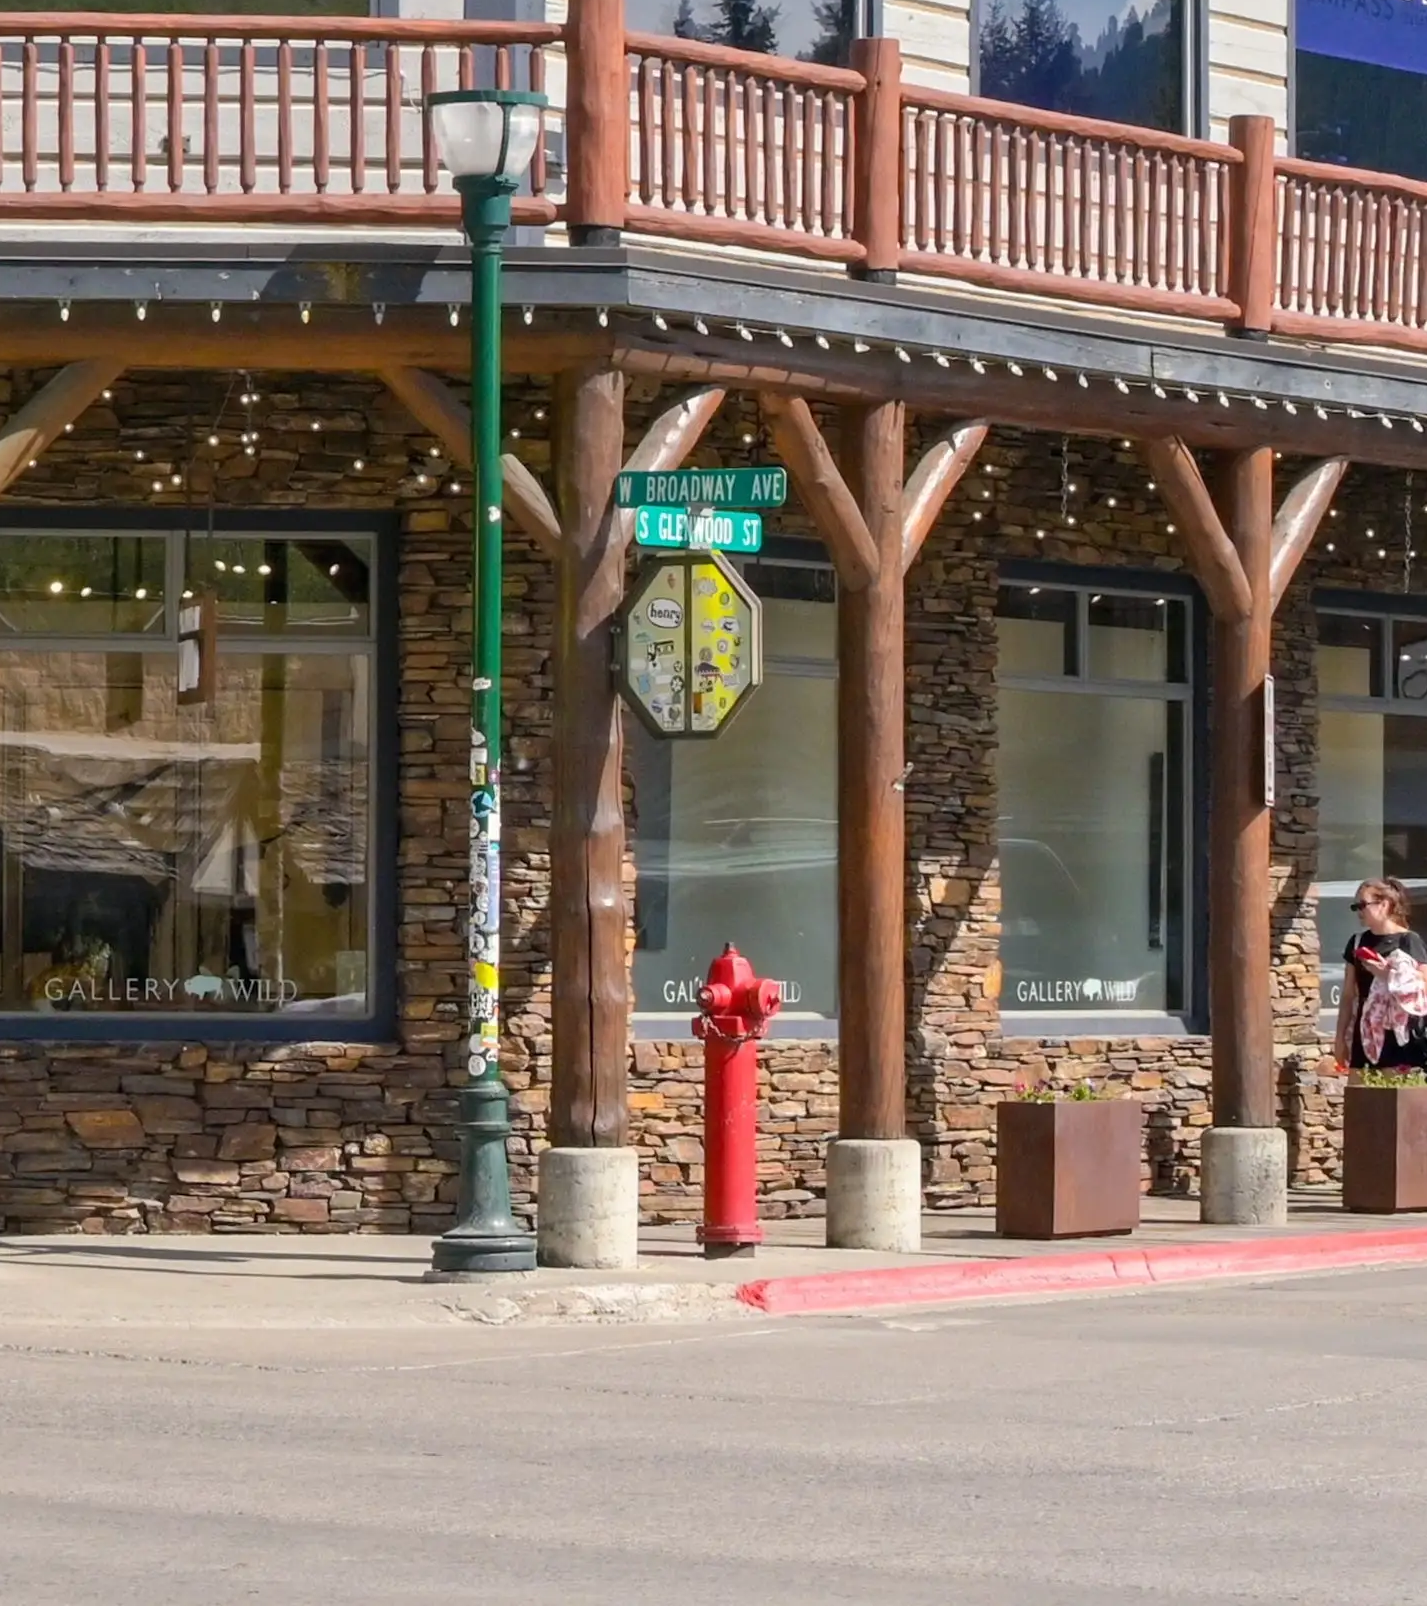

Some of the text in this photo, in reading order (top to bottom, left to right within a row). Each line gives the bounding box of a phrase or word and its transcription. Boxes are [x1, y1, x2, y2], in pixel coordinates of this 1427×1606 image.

[619, 473, 783, 503] W BROADWAY AVE
[639, 511, 759, 547] S GLENWOOD ST
[650, 602, 681, 625] henry
[44, 977, 298, 1002] GALLERY WILD
[778, 981, 802, 1003] ILD
[1017, 980, 1137, 1002] GALLERY WILD
